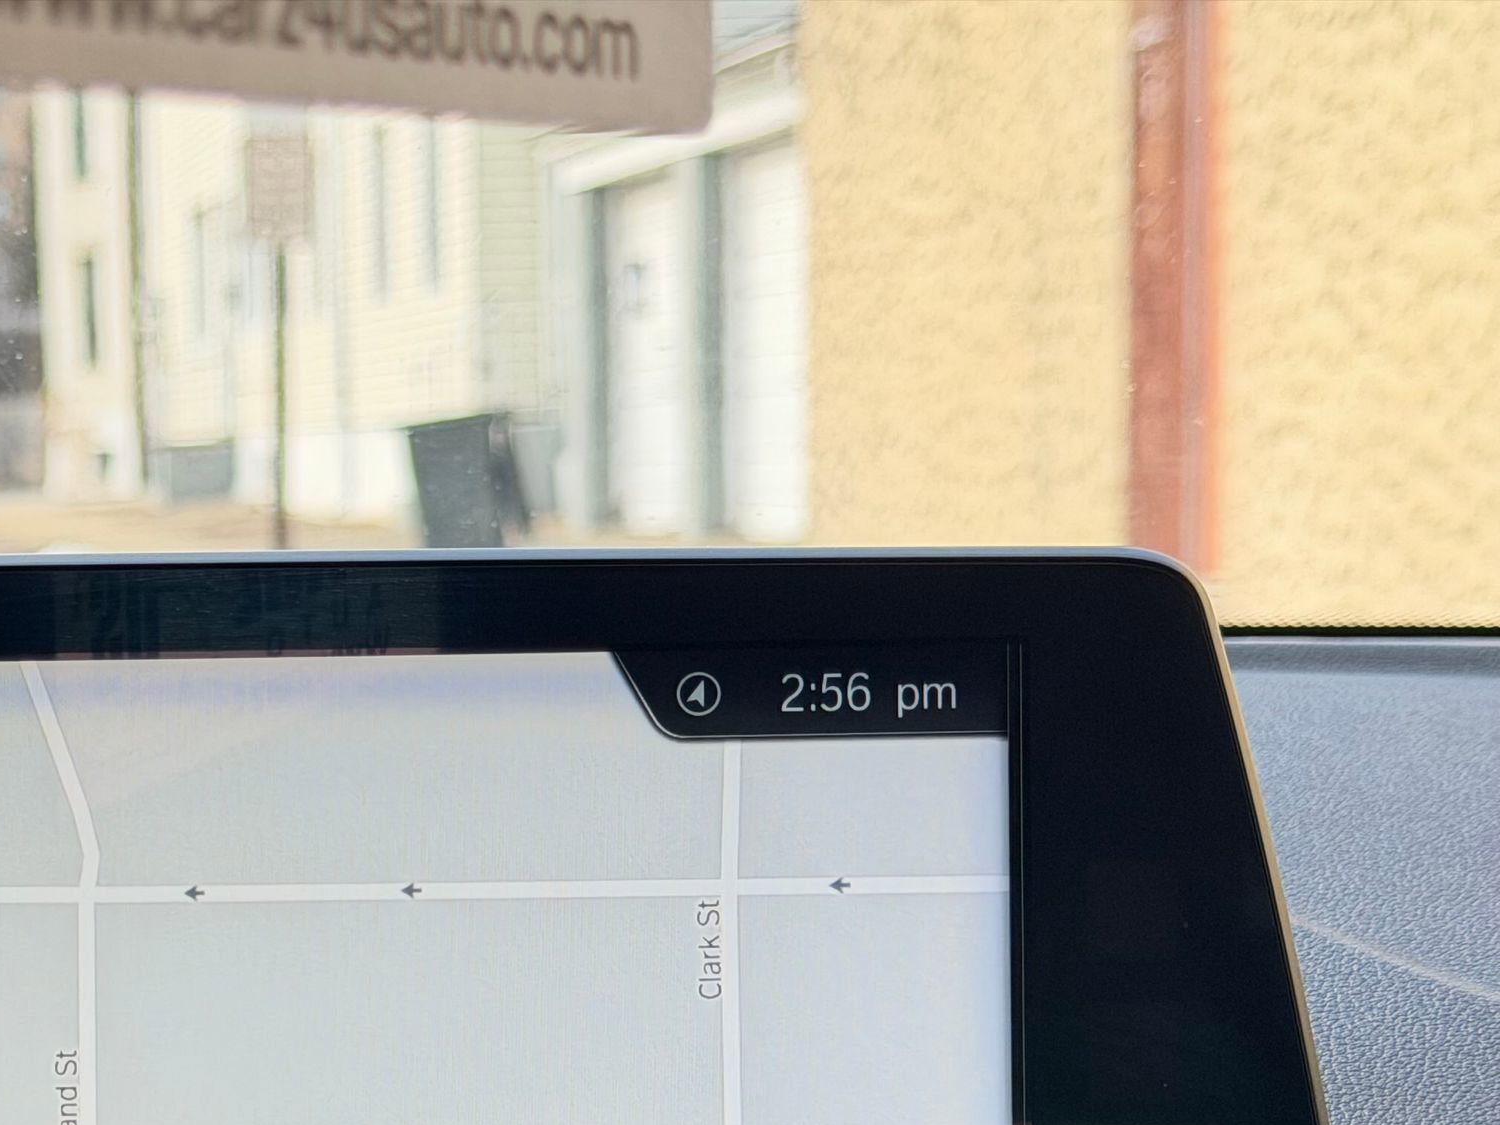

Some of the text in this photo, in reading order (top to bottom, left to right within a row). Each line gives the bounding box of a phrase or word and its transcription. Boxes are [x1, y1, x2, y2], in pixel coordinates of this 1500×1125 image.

[780, 672, 958, 719] 2:56 pm
[695, 899, 722, 999] Clark St
[54, 1050, 78, 1076] St
